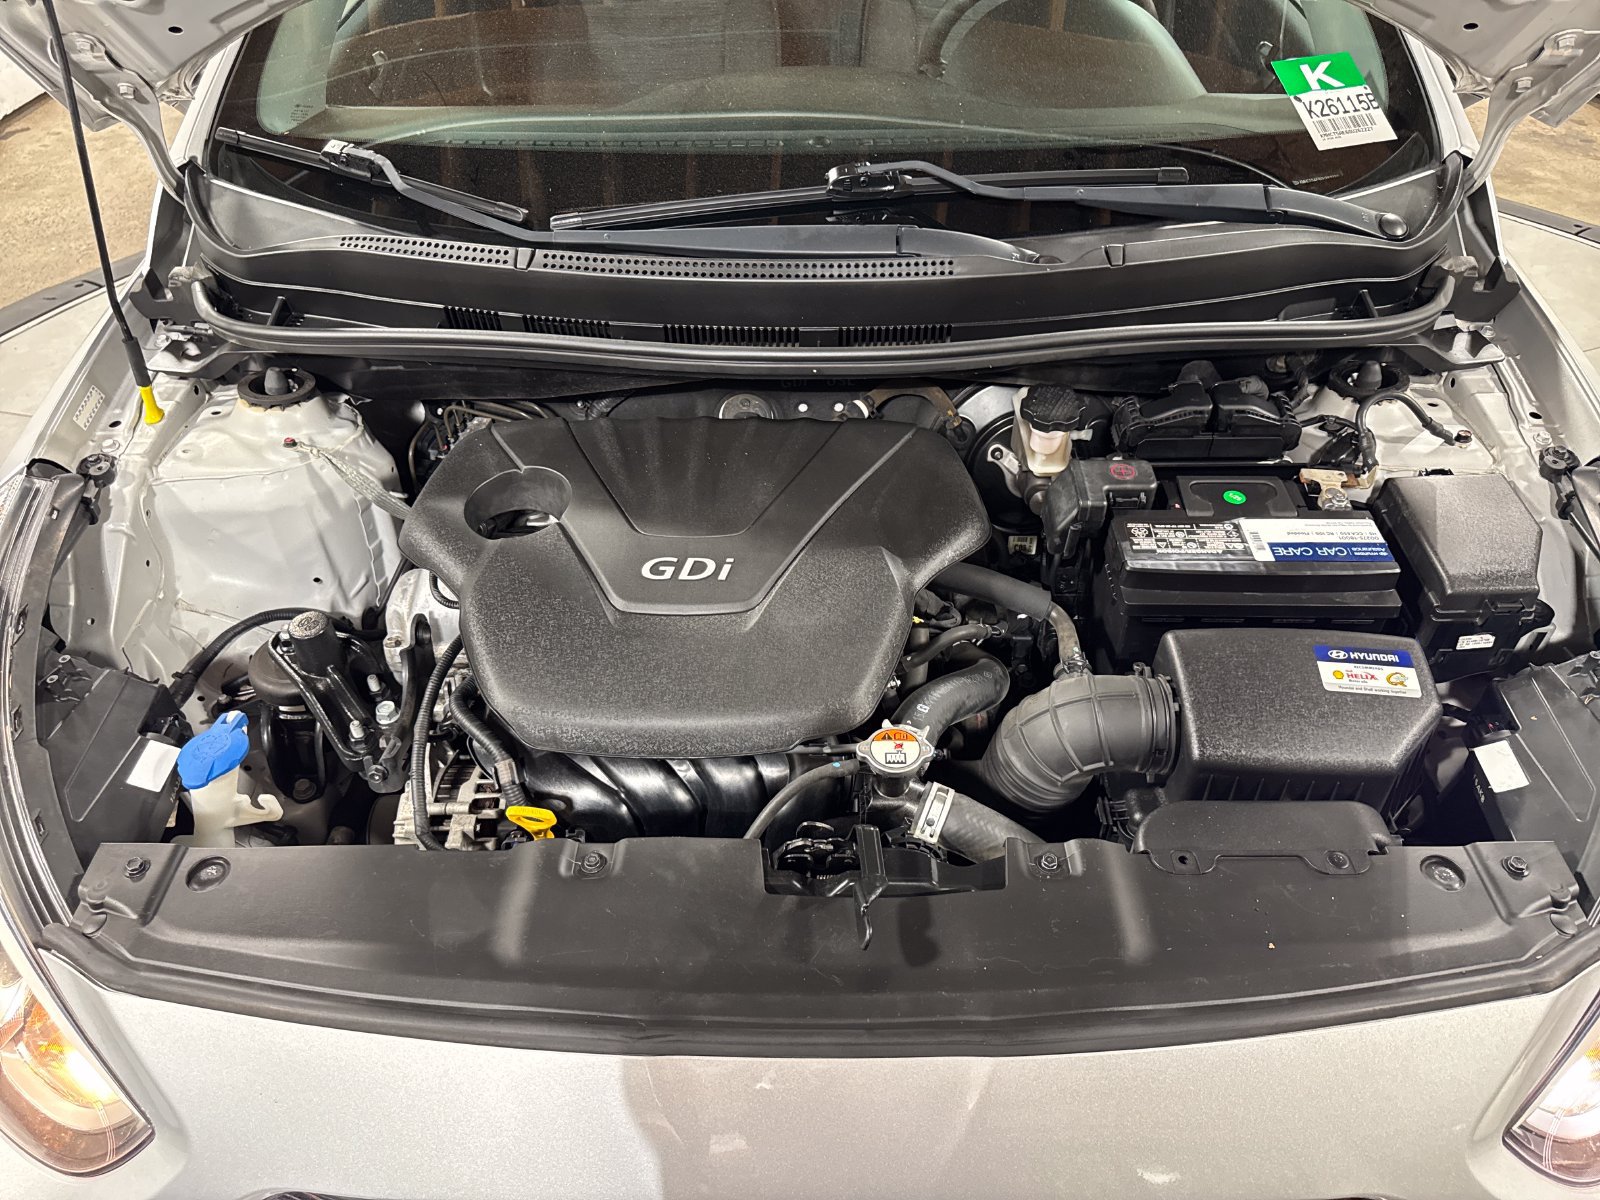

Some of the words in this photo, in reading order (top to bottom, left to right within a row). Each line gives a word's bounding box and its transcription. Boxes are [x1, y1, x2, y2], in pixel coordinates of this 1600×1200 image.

[1300, 61, 1345, 90] K
[1302, 92, 1380, 119] K26115B
[1272, 547, 1314, 556] CARE
[1316, 547, 1347, 556] CAR
[641, 556, 735, 580] GDi
[1349, 652, 1400, 663] HYUNDAI
[1346, 671, 1379, 681] HELIX
